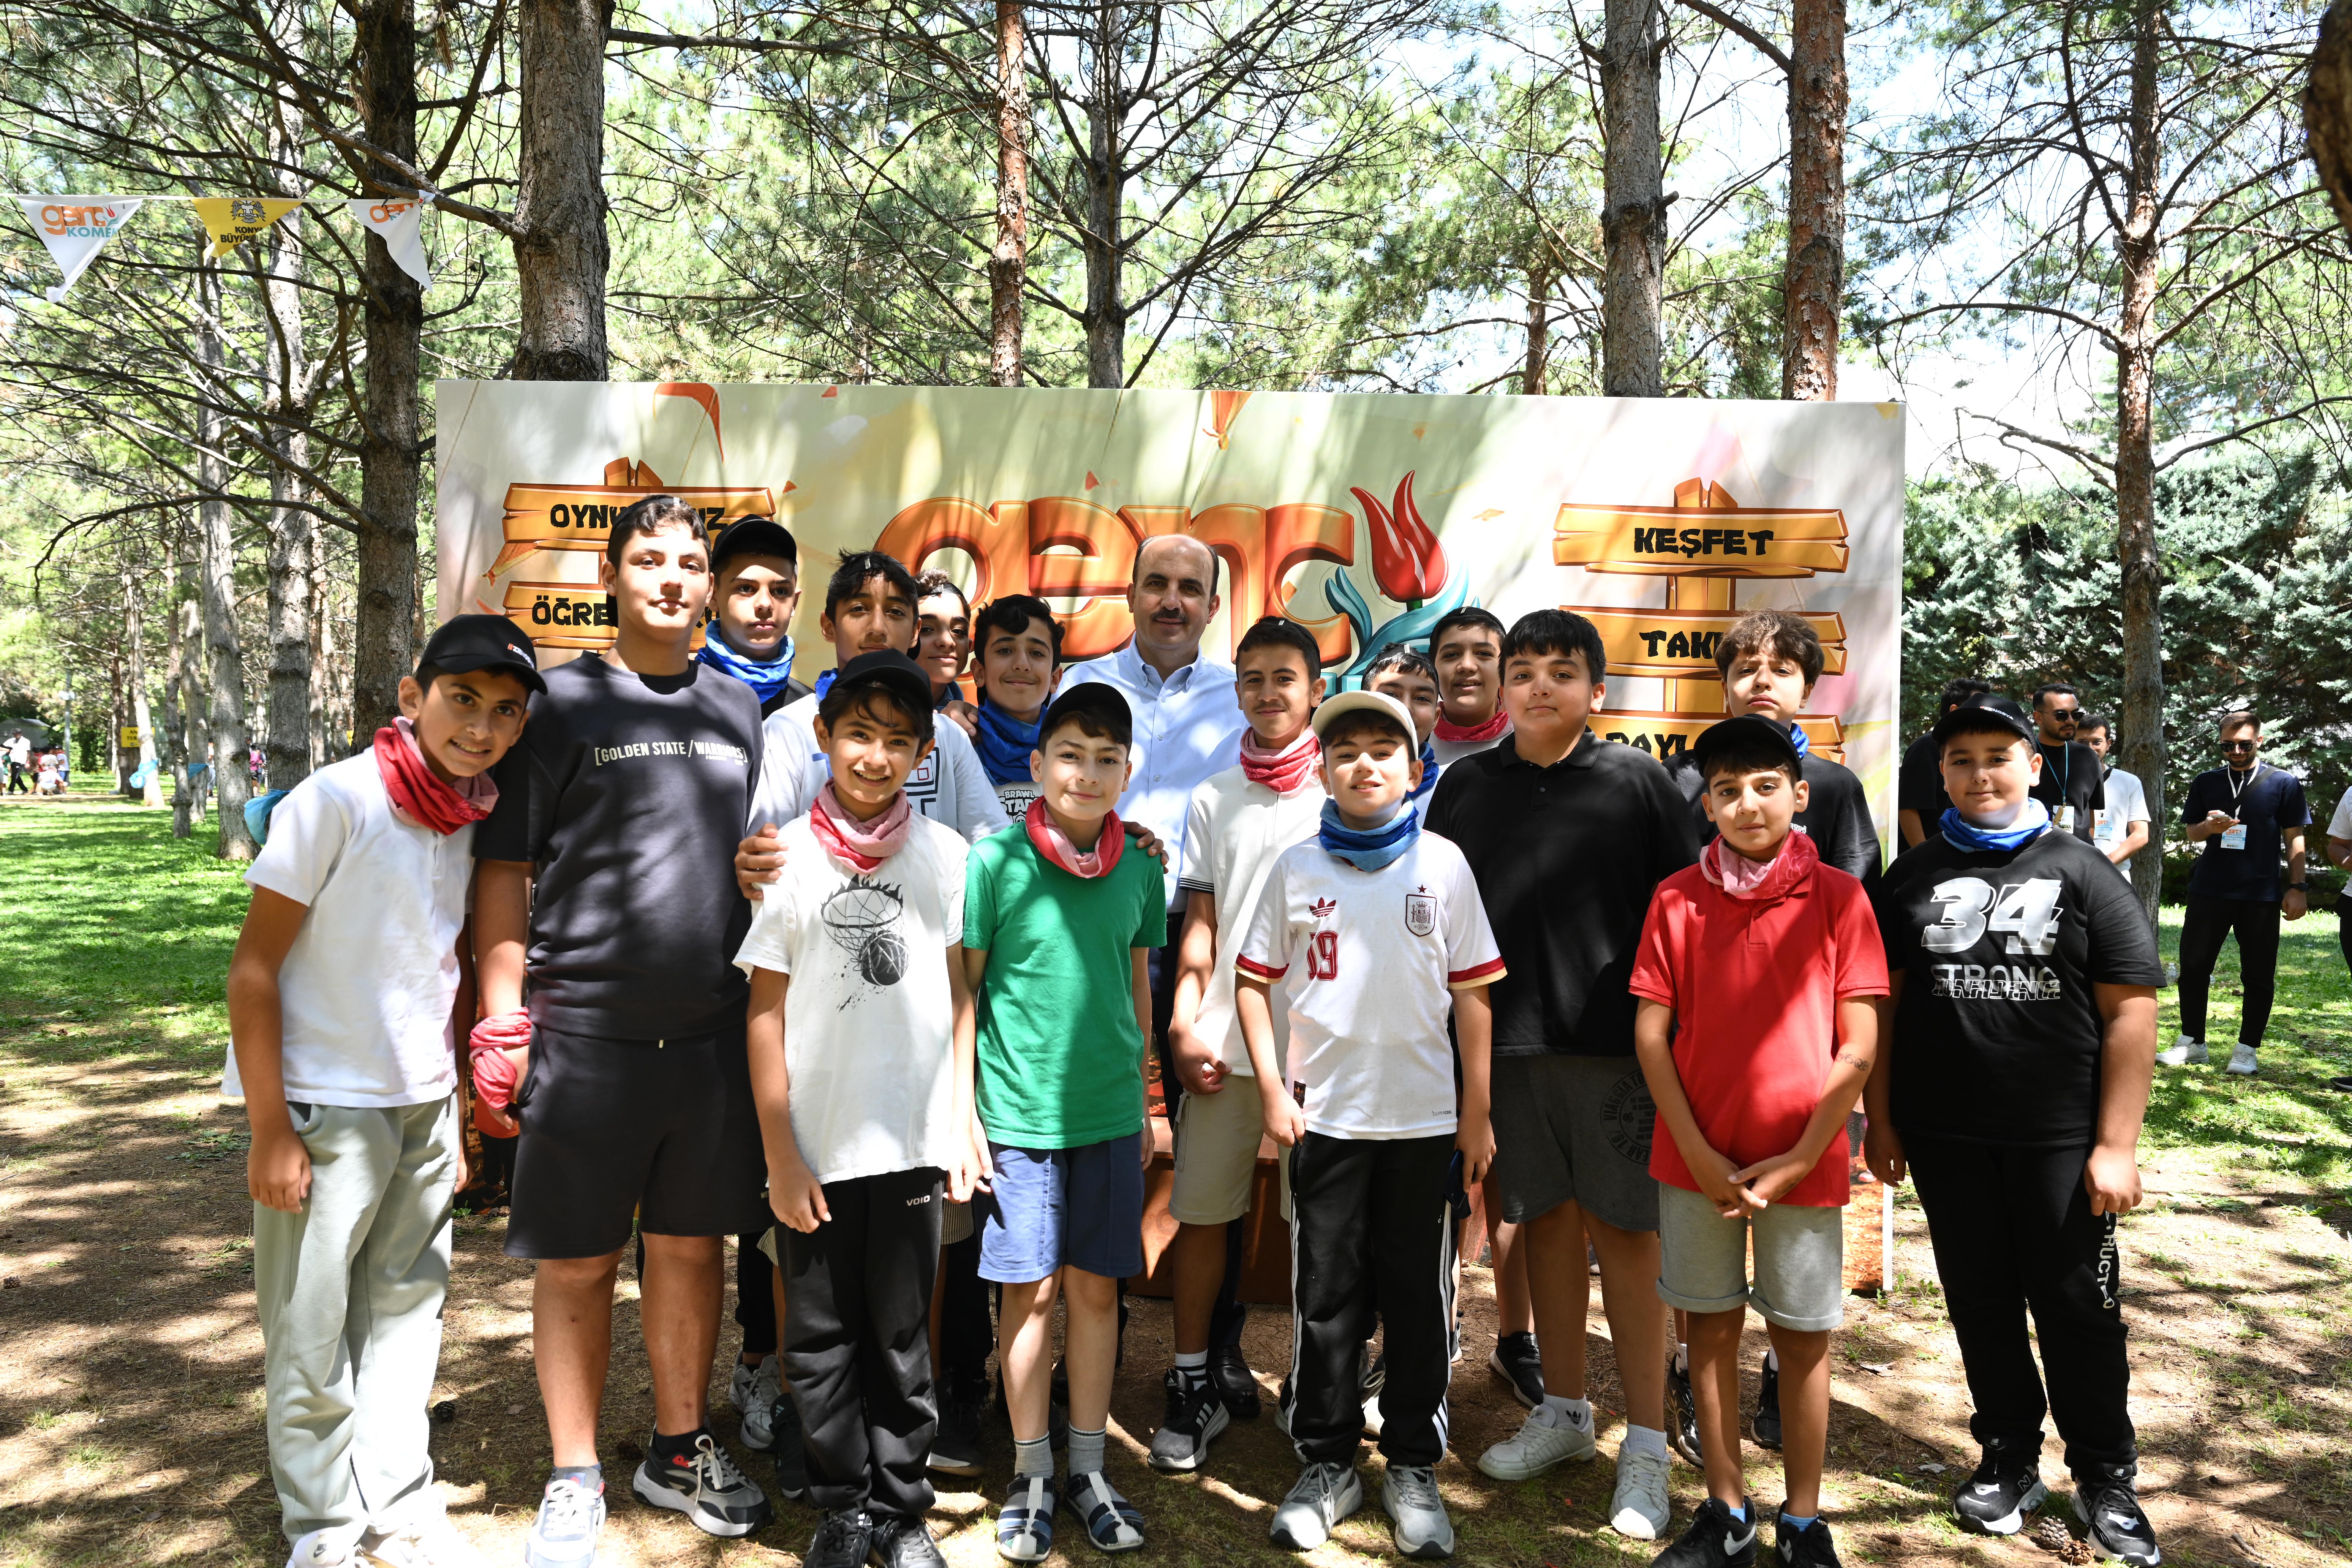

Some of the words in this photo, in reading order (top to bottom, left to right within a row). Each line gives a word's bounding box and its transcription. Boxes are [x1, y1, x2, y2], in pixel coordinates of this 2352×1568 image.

[1634, 528, 1774, 558] KEŞFET
[1004, 790, 1035, 798] BRAWL
[1922, 877, 2063, 955] 34
[1307, 931, 1339, 982] 19
[1603, 1072, 1645, 1121] VIAGGIATO
[906, 1195, 930, 1206] VOID
